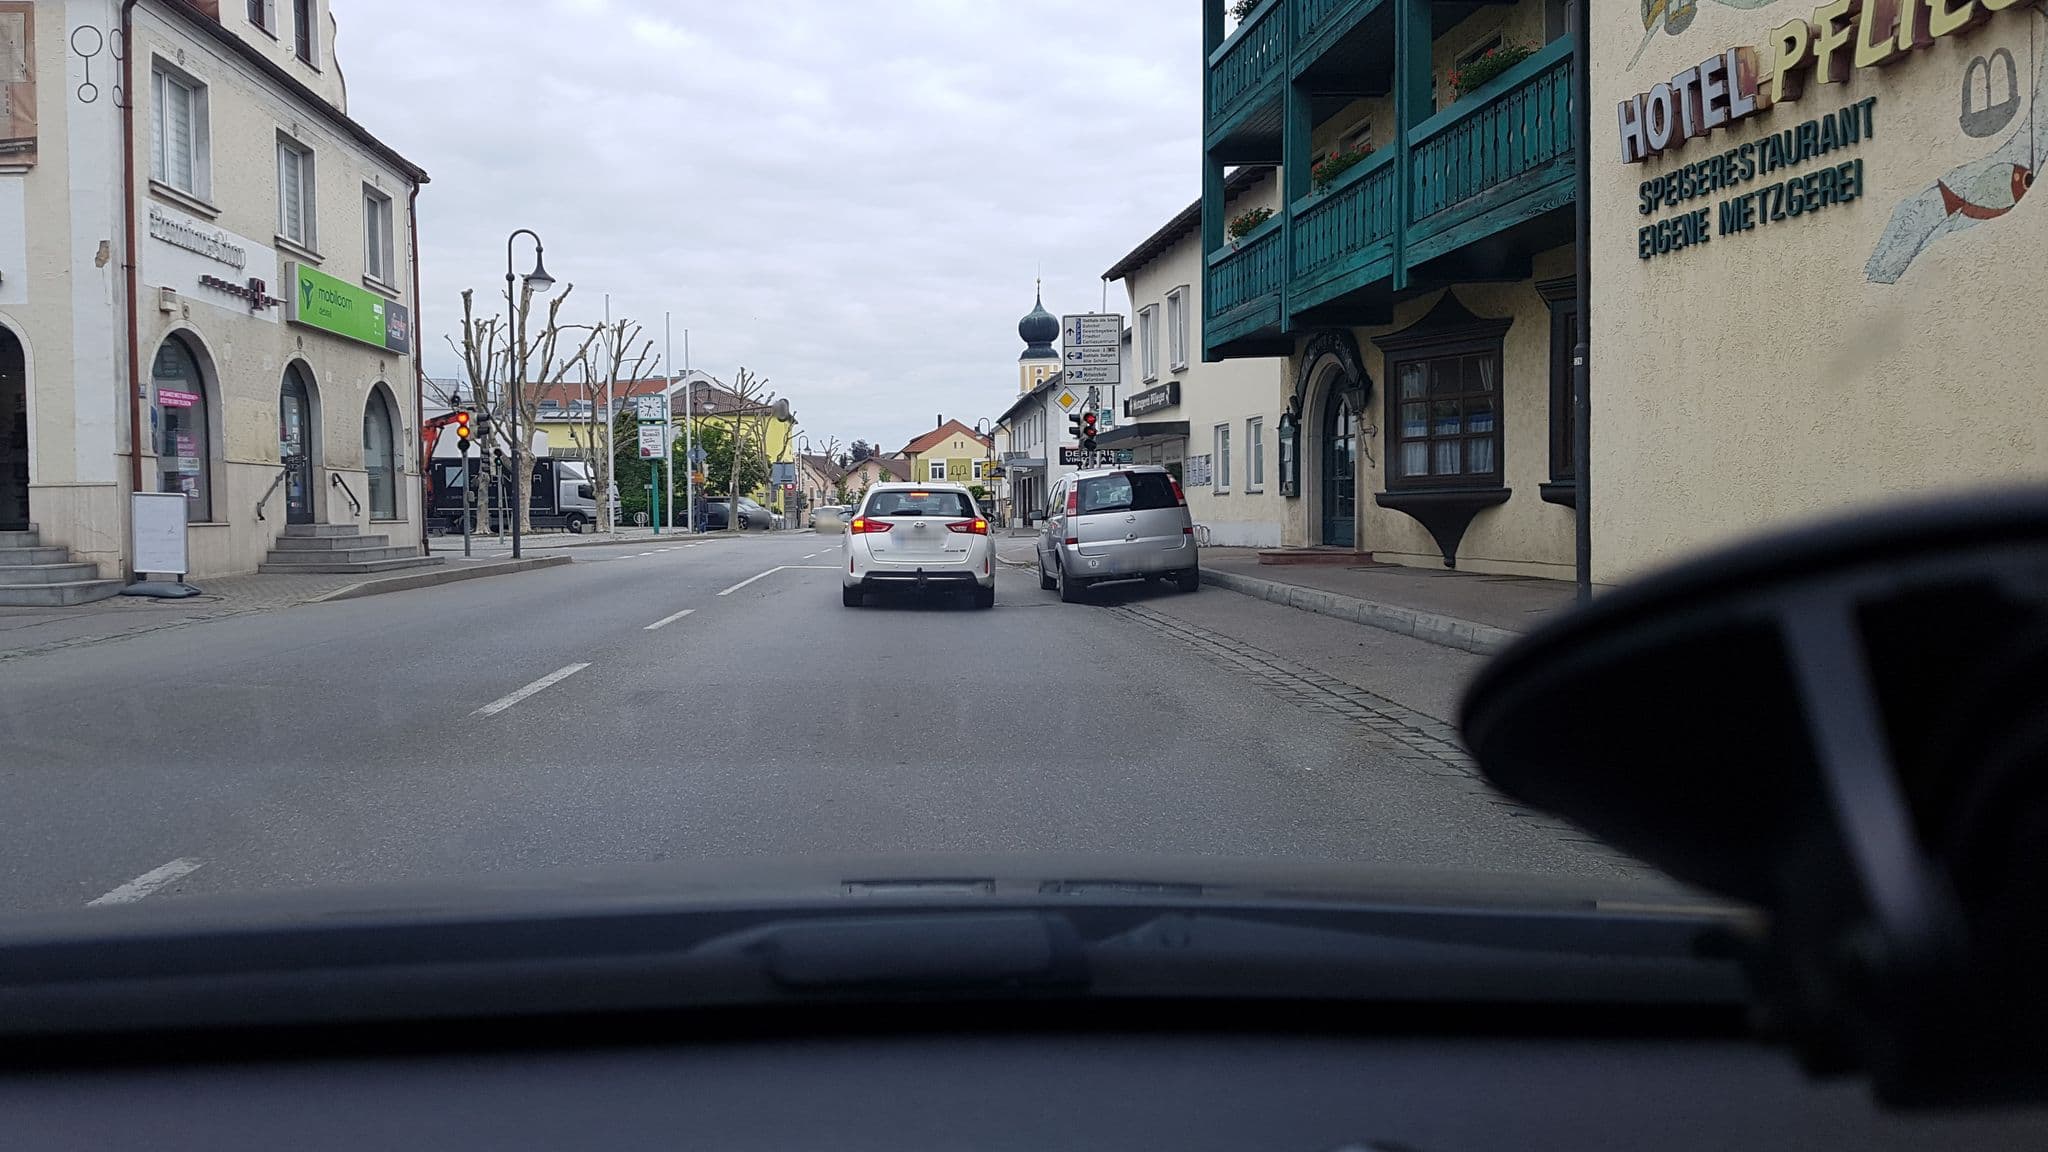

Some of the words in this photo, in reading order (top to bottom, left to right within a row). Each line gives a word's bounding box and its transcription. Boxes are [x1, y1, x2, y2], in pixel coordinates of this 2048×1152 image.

[1619, 46, 1757, 164] HOTEL
[1638, 97, 1877, 216] SPEISERESTAURANT
[1638, 206, 1711, 260] EIGENE
[1718, 158, 1863, 237] METZGEREI
[318, 287, 353, 311] mobilcom
